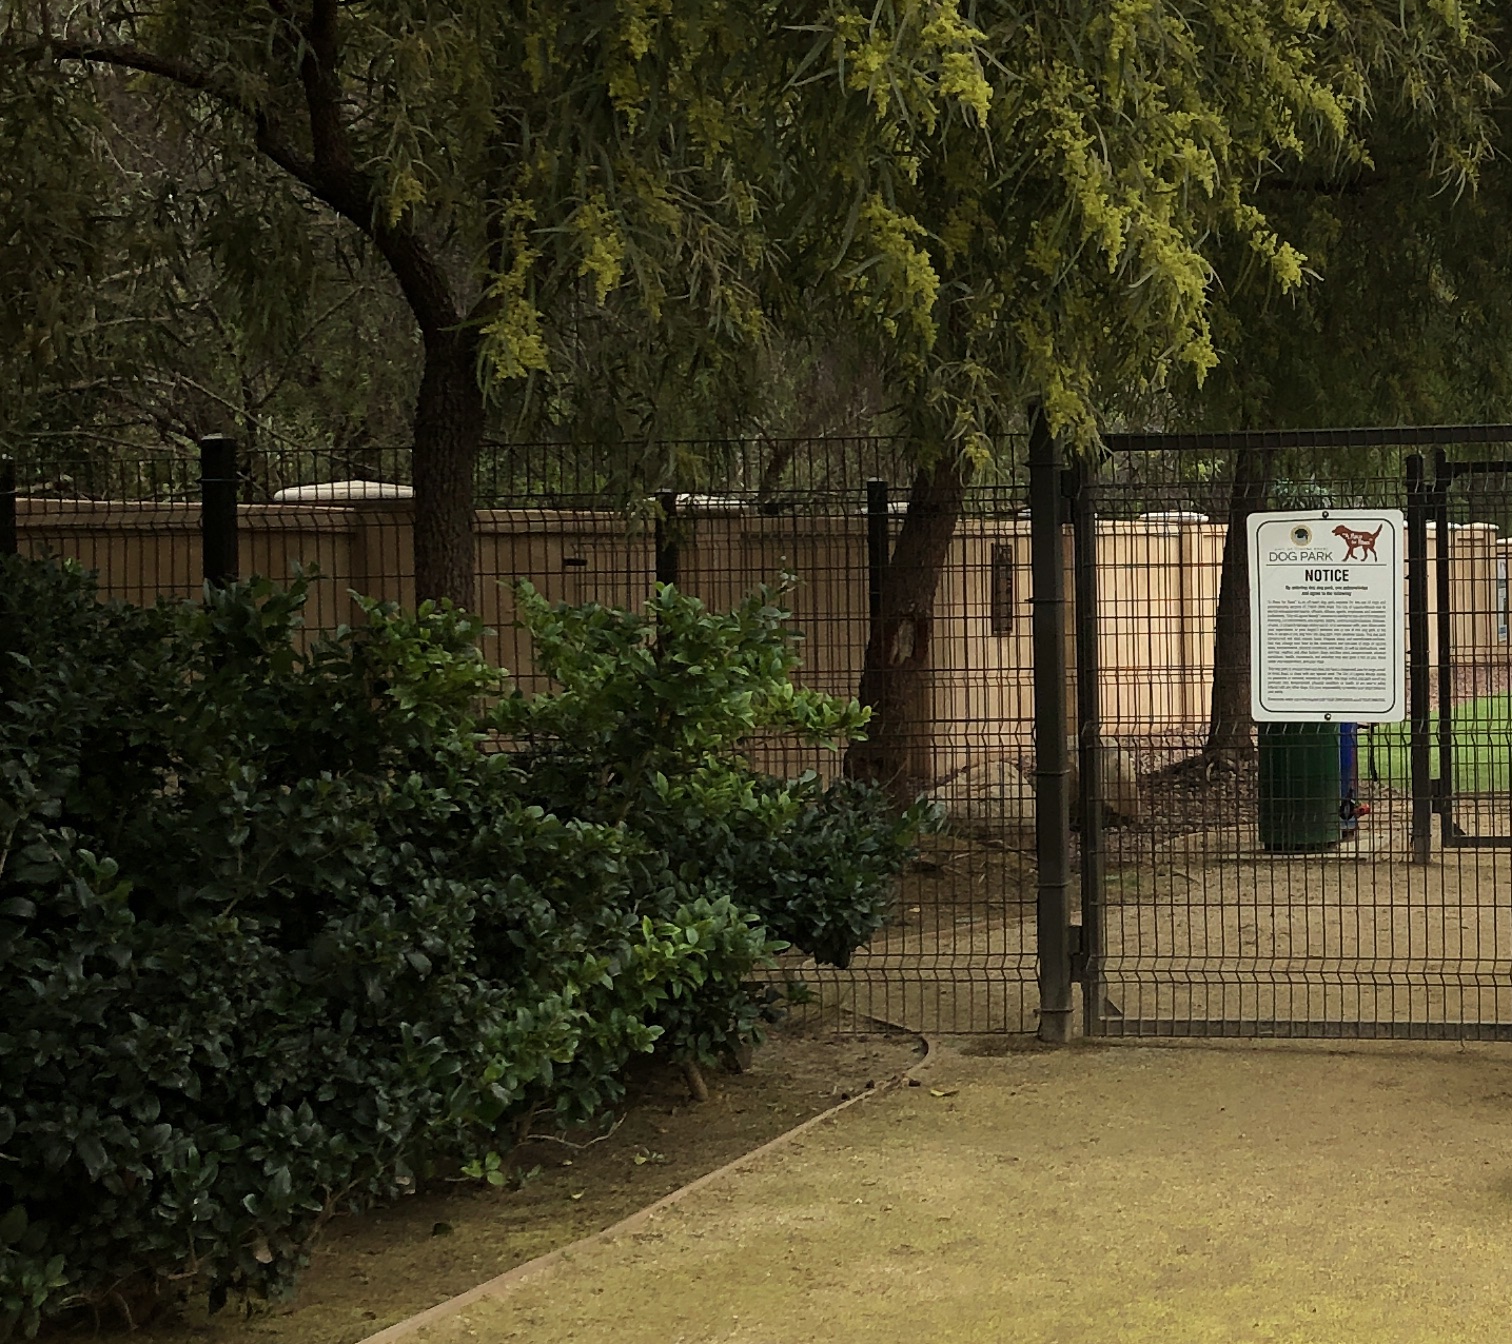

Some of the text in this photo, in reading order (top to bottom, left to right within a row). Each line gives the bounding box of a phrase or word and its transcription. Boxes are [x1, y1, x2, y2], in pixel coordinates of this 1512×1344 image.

[1269, 551, 1334, 562] DOG PARK
[1305, 569, 1350, 582] NOTICE
